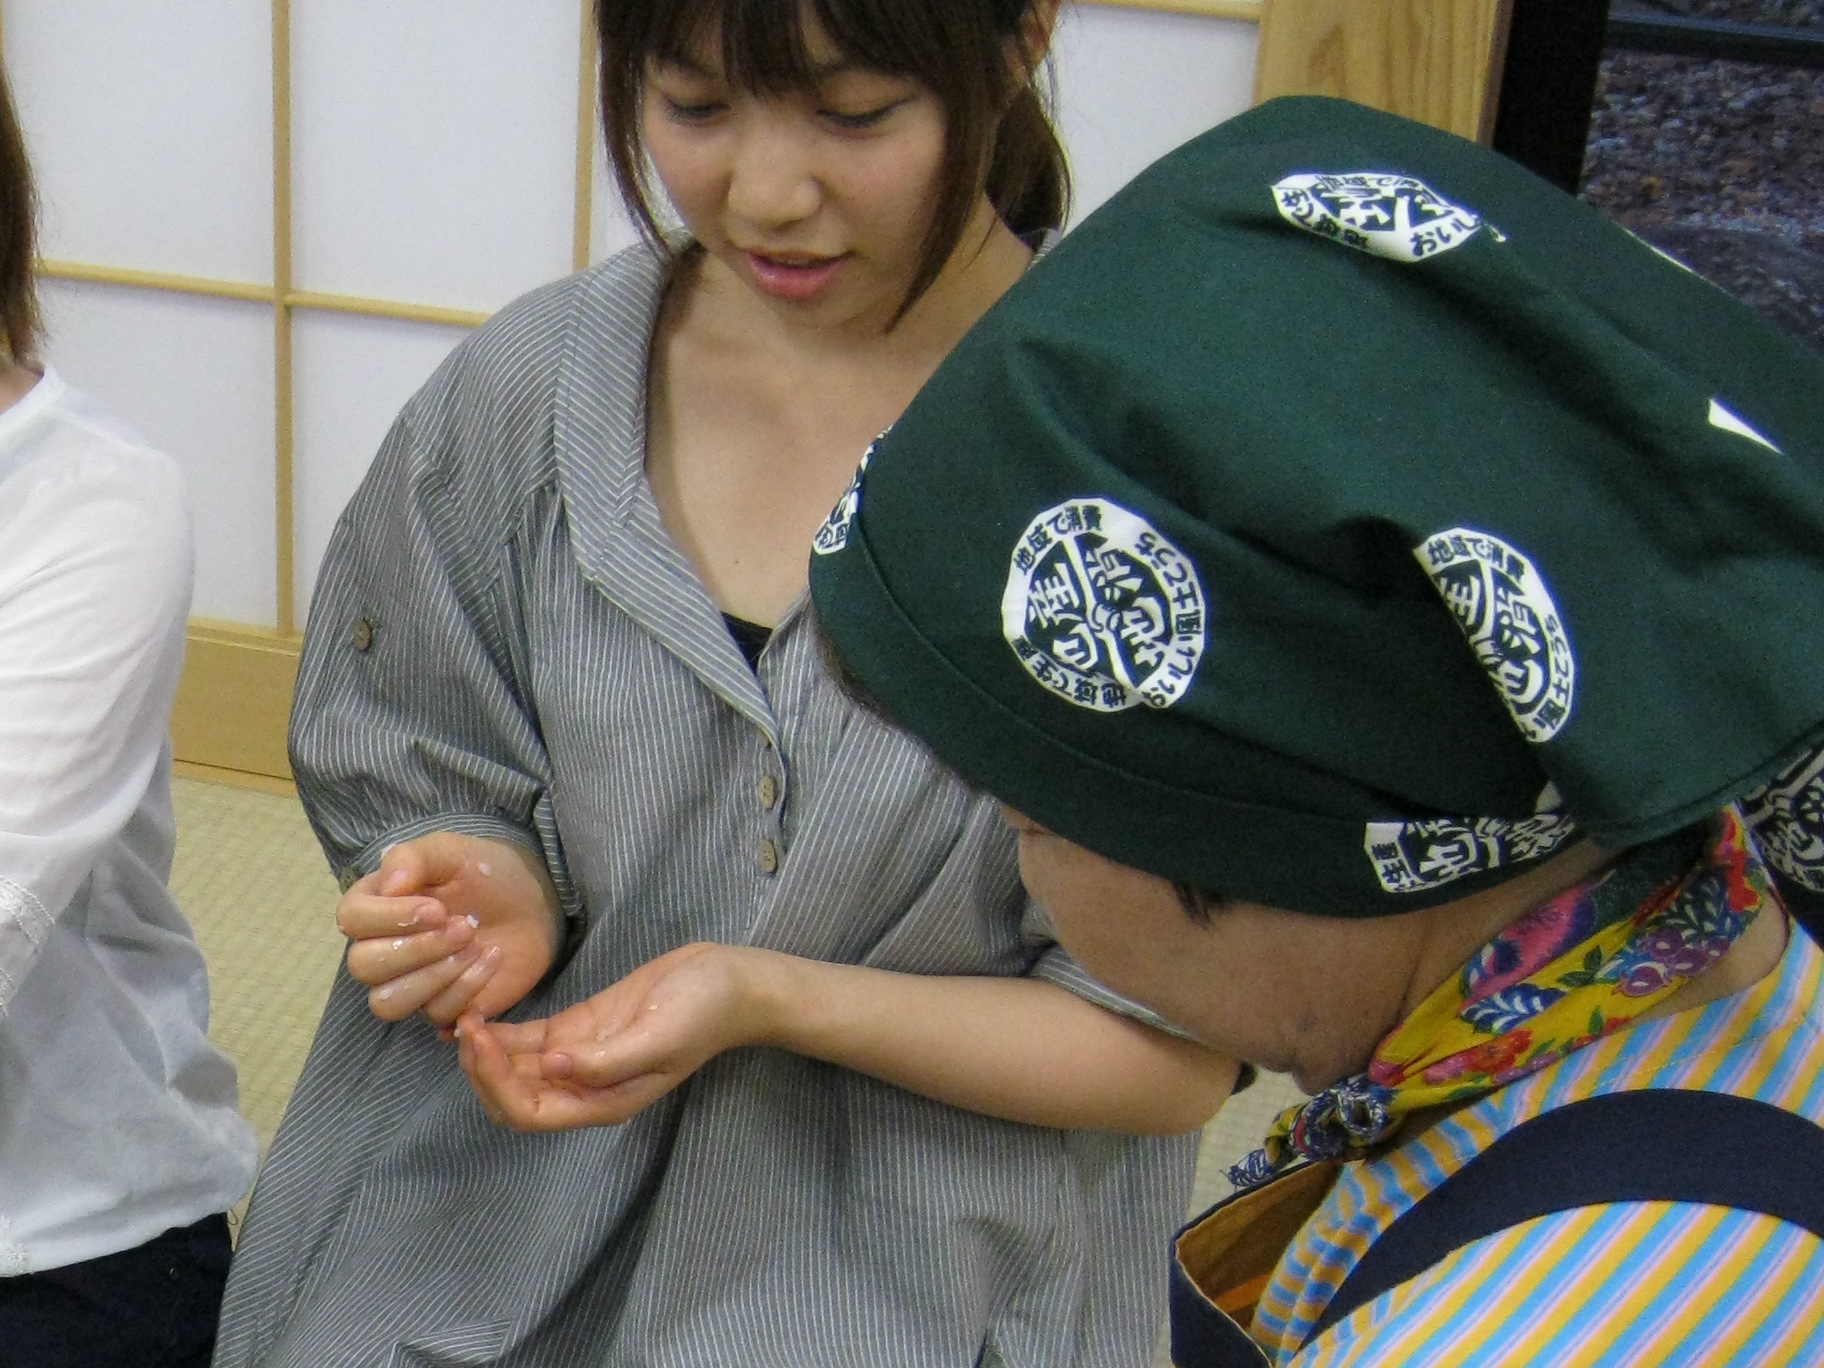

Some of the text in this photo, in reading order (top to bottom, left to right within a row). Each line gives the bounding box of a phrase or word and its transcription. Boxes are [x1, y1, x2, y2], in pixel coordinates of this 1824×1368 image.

[1014, 504, 1103, 576] 地域で消費
